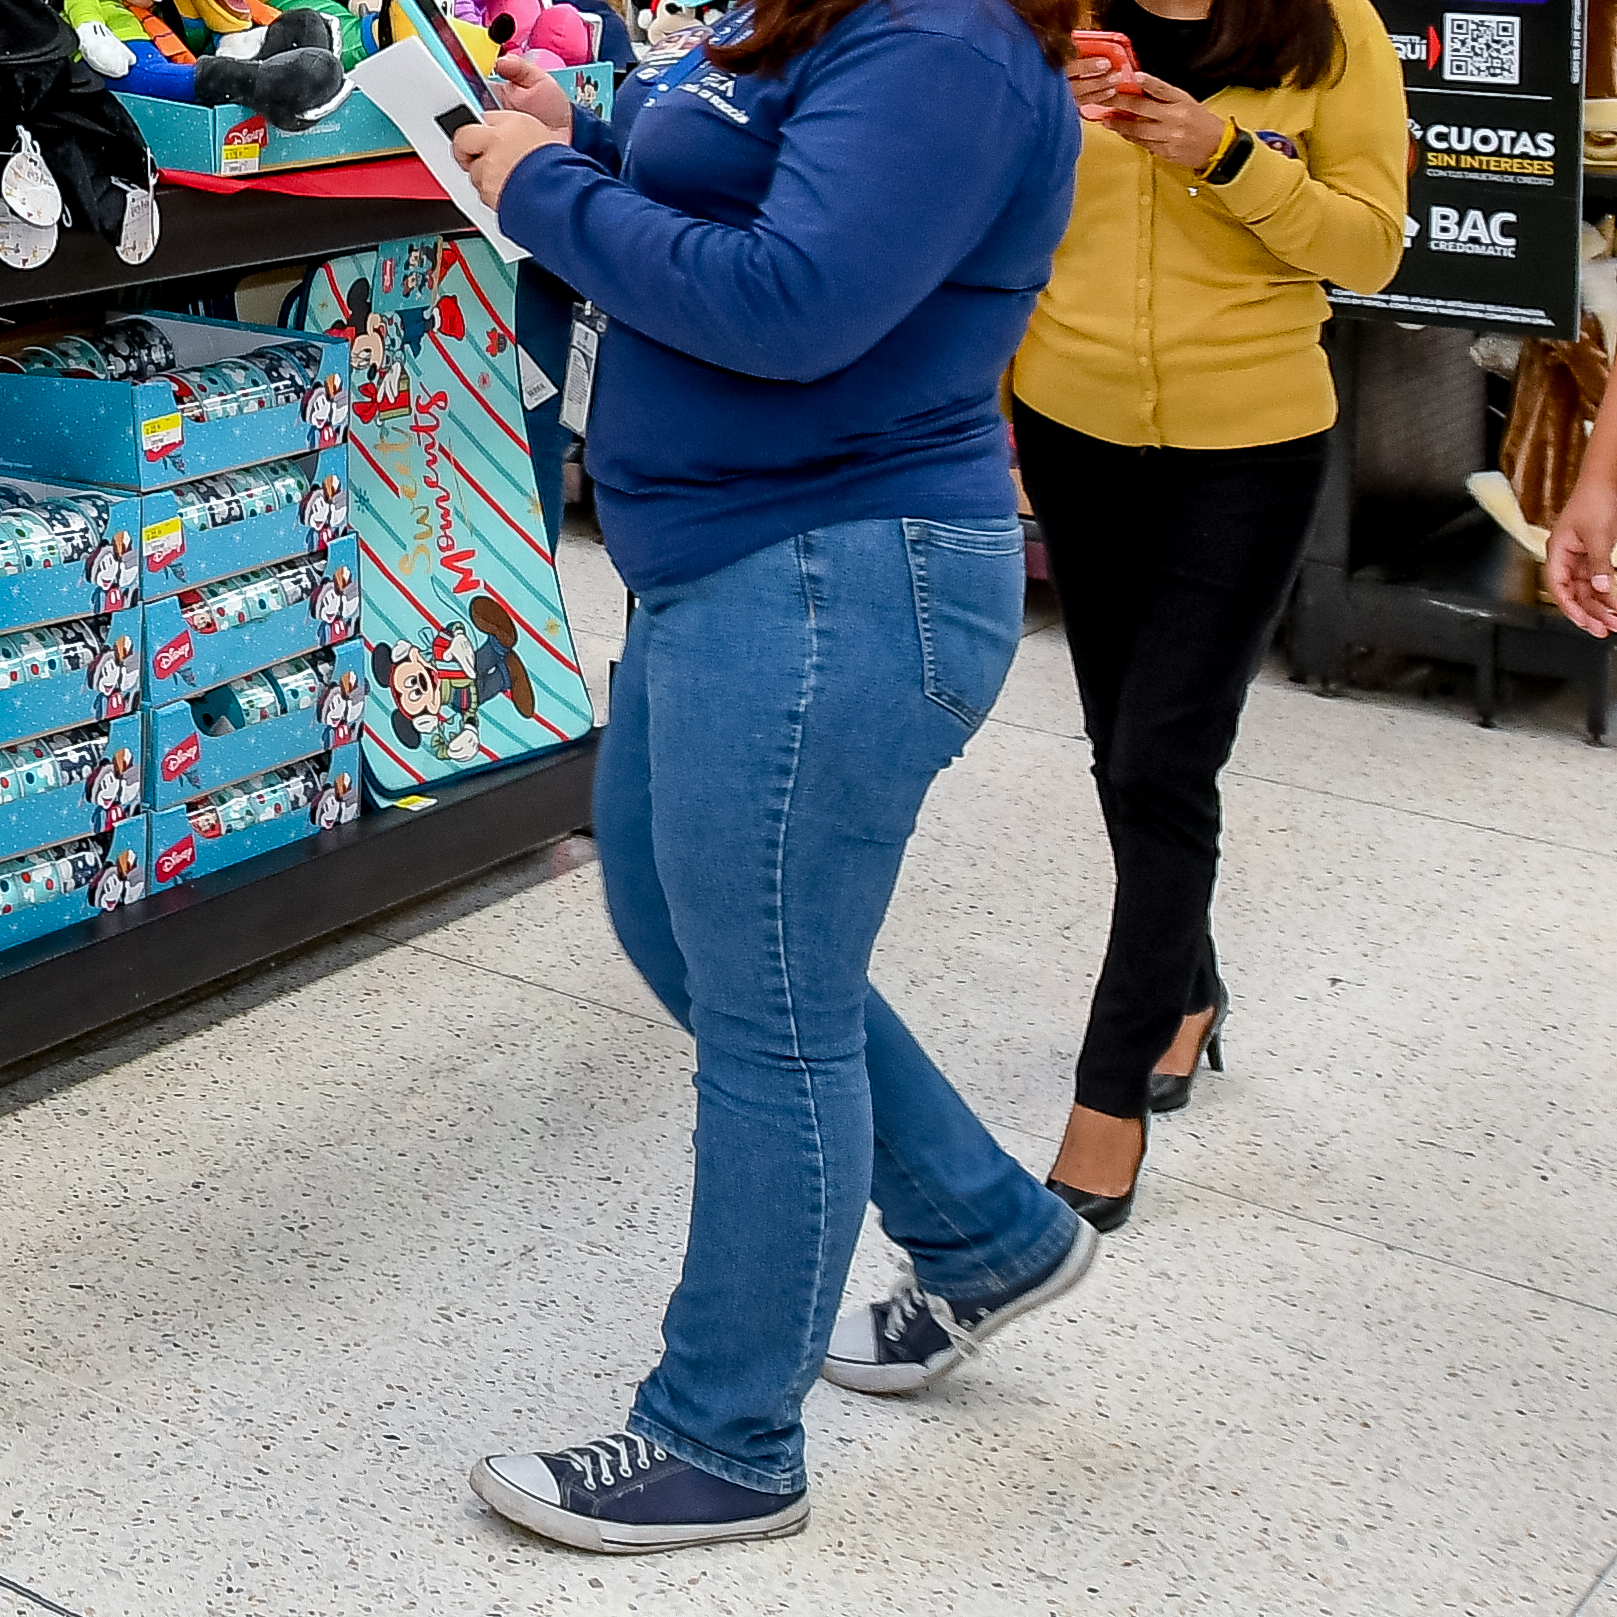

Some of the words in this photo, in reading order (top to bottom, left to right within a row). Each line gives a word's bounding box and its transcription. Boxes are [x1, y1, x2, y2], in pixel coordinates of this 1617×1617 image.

[1426, 124, 1556, 158] CUOTAS
[1426, 152, 1456, 167] SIN
[1460, 154, 1555, 175] INTERESES
[1429, 205, 1518, 246] BAC
[1430, 240, 1517, 258] CREDOMATIC
[409, 382, 481, 594] Moments
[156, 642, 190, 670] Disney
[164, 745, 198, 773] Disney
[158, 846, 193, 873] Disney
